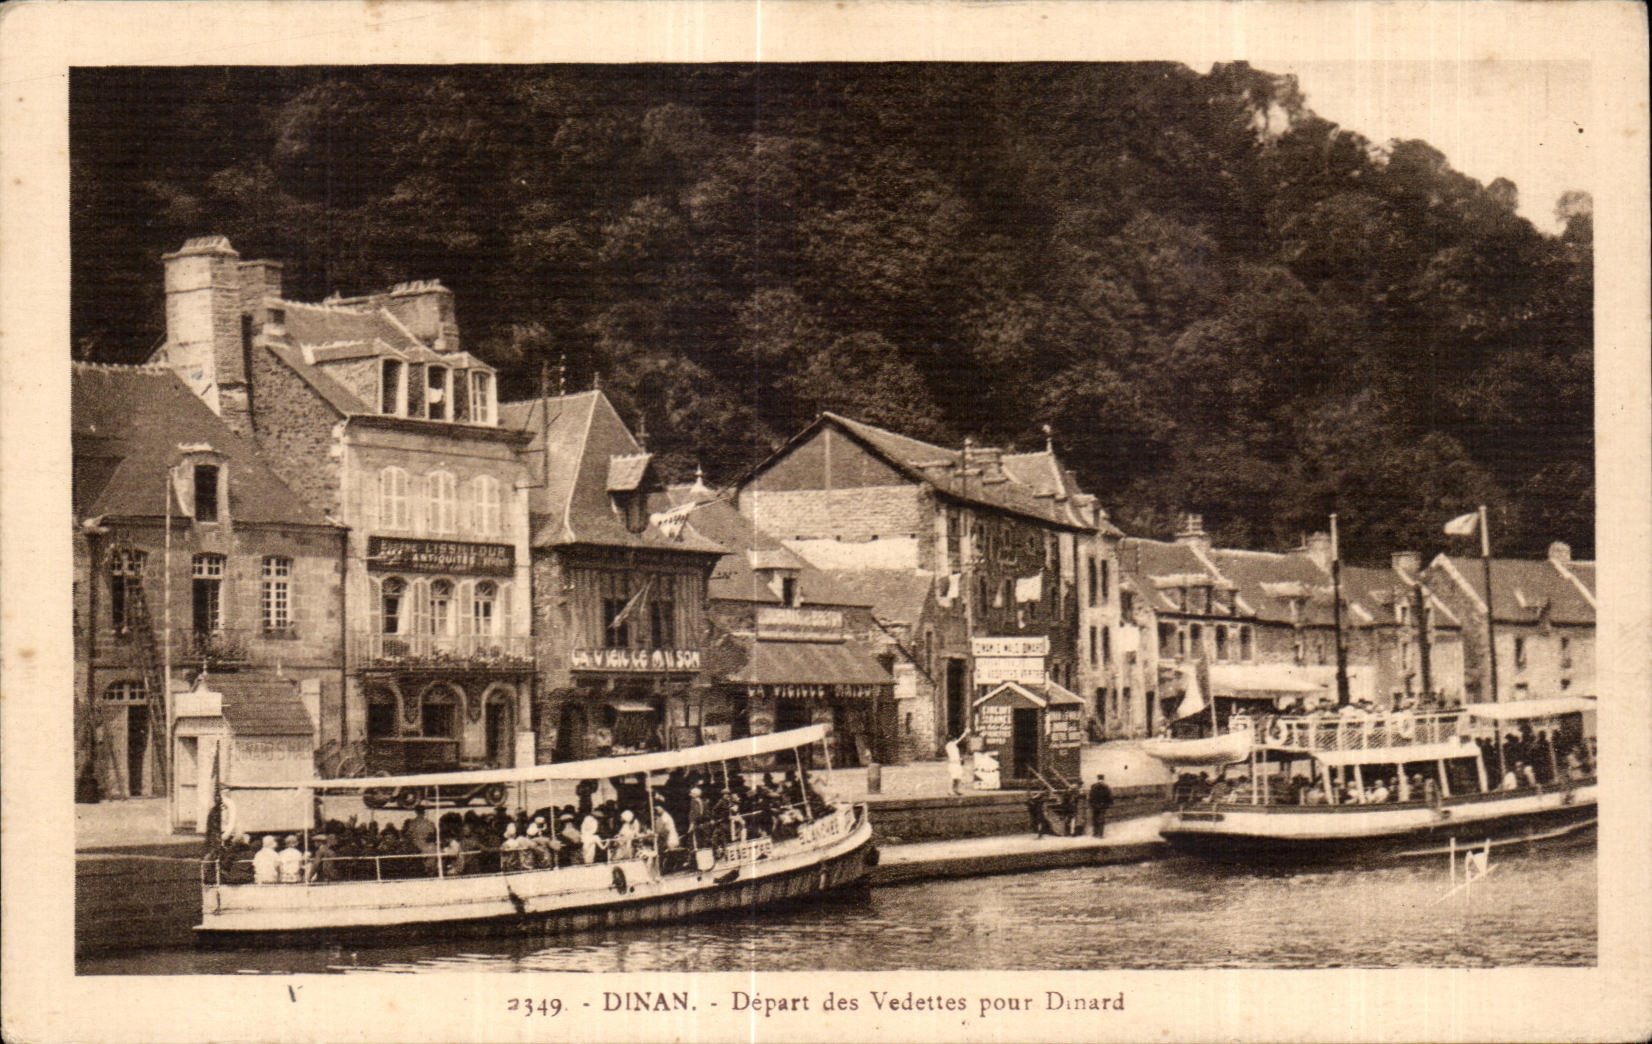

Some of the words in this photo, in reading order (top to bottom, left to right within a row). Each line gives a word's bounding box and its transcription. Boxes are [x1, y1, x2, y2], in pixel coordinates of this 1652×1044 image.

[571, 648, 590, 667] LA
[593, 649, 648, 668] VIEILLE
[747, 685, 765, 698] LA
